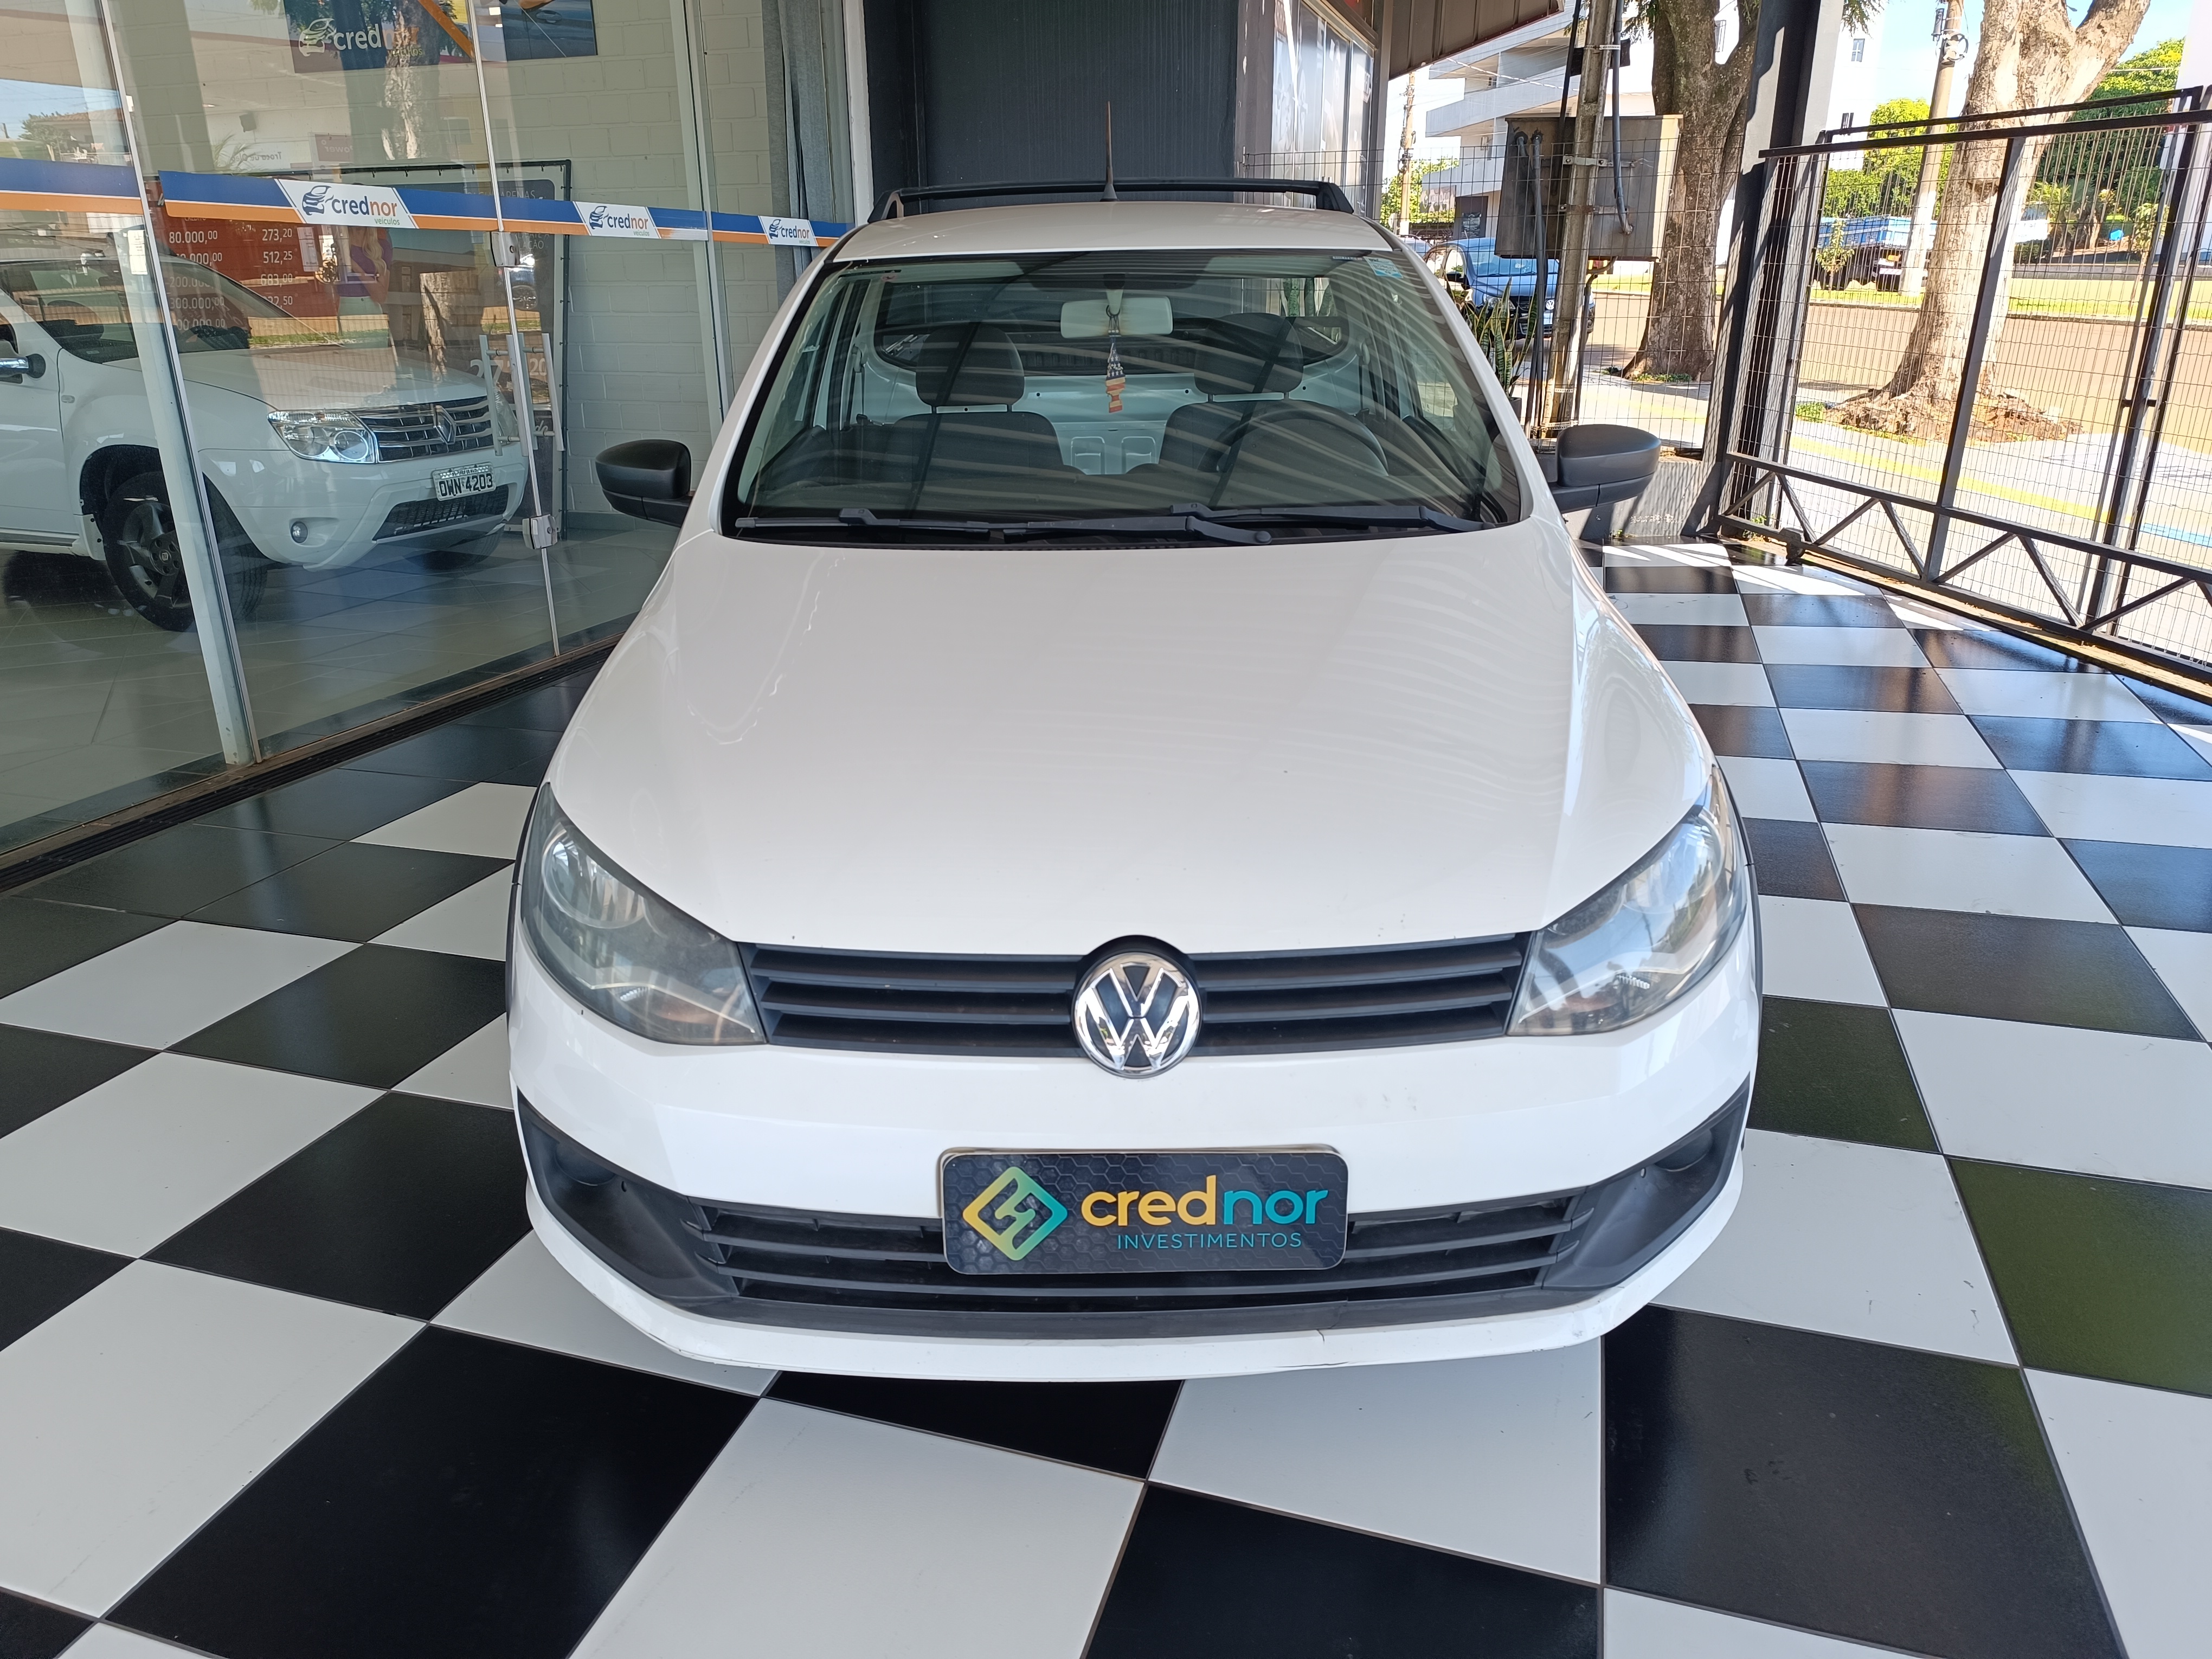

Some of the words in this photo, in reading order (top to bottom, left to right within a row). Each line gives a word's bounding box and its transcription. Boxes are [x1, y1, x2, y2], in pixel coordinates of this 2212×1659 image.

[331, 196, 397, 216] crednor
[607, 214, 648, 229] crednor
[169, 230, 218, 245] 80.000,00
[262, 228, 292, 242] 273,20
[781, 226, 809, 239] crednor
[263, 251, 293, 265] 512,25
[261, 273, 293, 287] 683,00
[1082, 1174, 1328, 1226] crednor
[1118, 1232, 1302, 1249] INVESTIMENTOS
